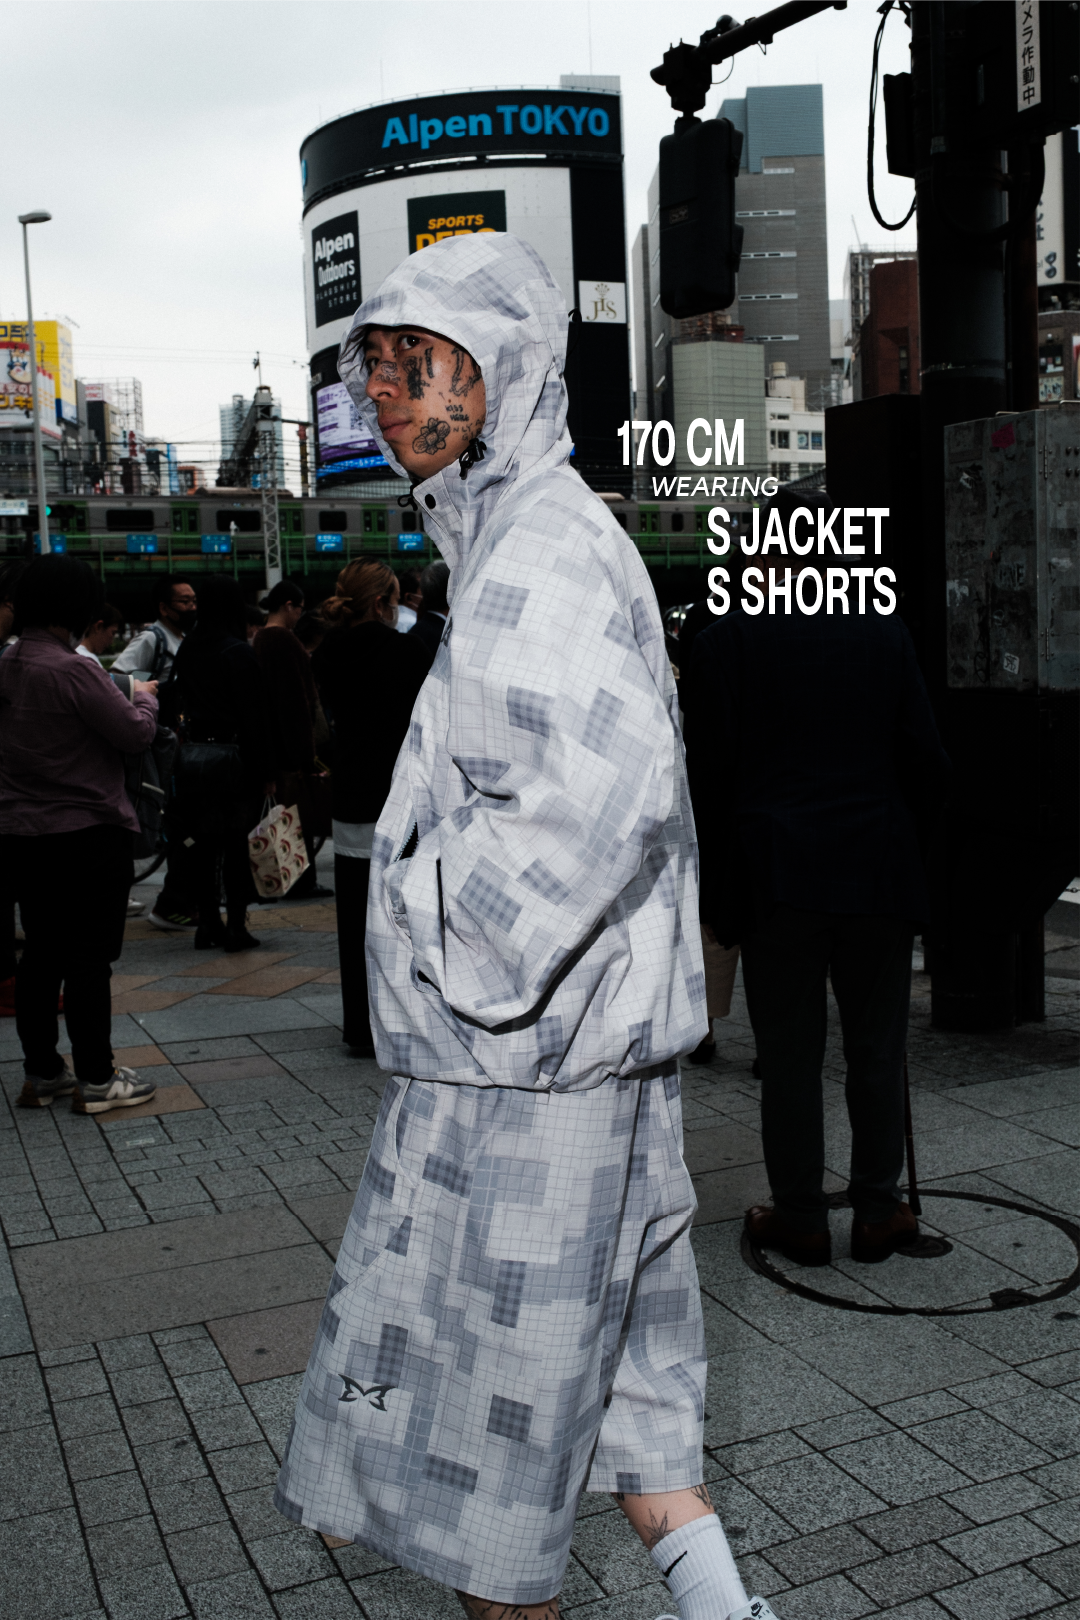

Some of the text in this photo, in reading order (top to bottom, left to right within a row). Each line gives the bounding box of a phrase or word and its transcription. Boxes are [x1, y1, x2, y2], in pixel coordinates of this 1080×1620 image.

[1021, 0, 1035, 105] メラ作動中
[381, 104, 610, 149] Alpen TOKYO
[427, 213, 485, 230] SPORTS
[315, 232, 355, 262] Alpen
[317, 259, 355, 287] Outdoors
[328, 292, 357, 308] STORE
